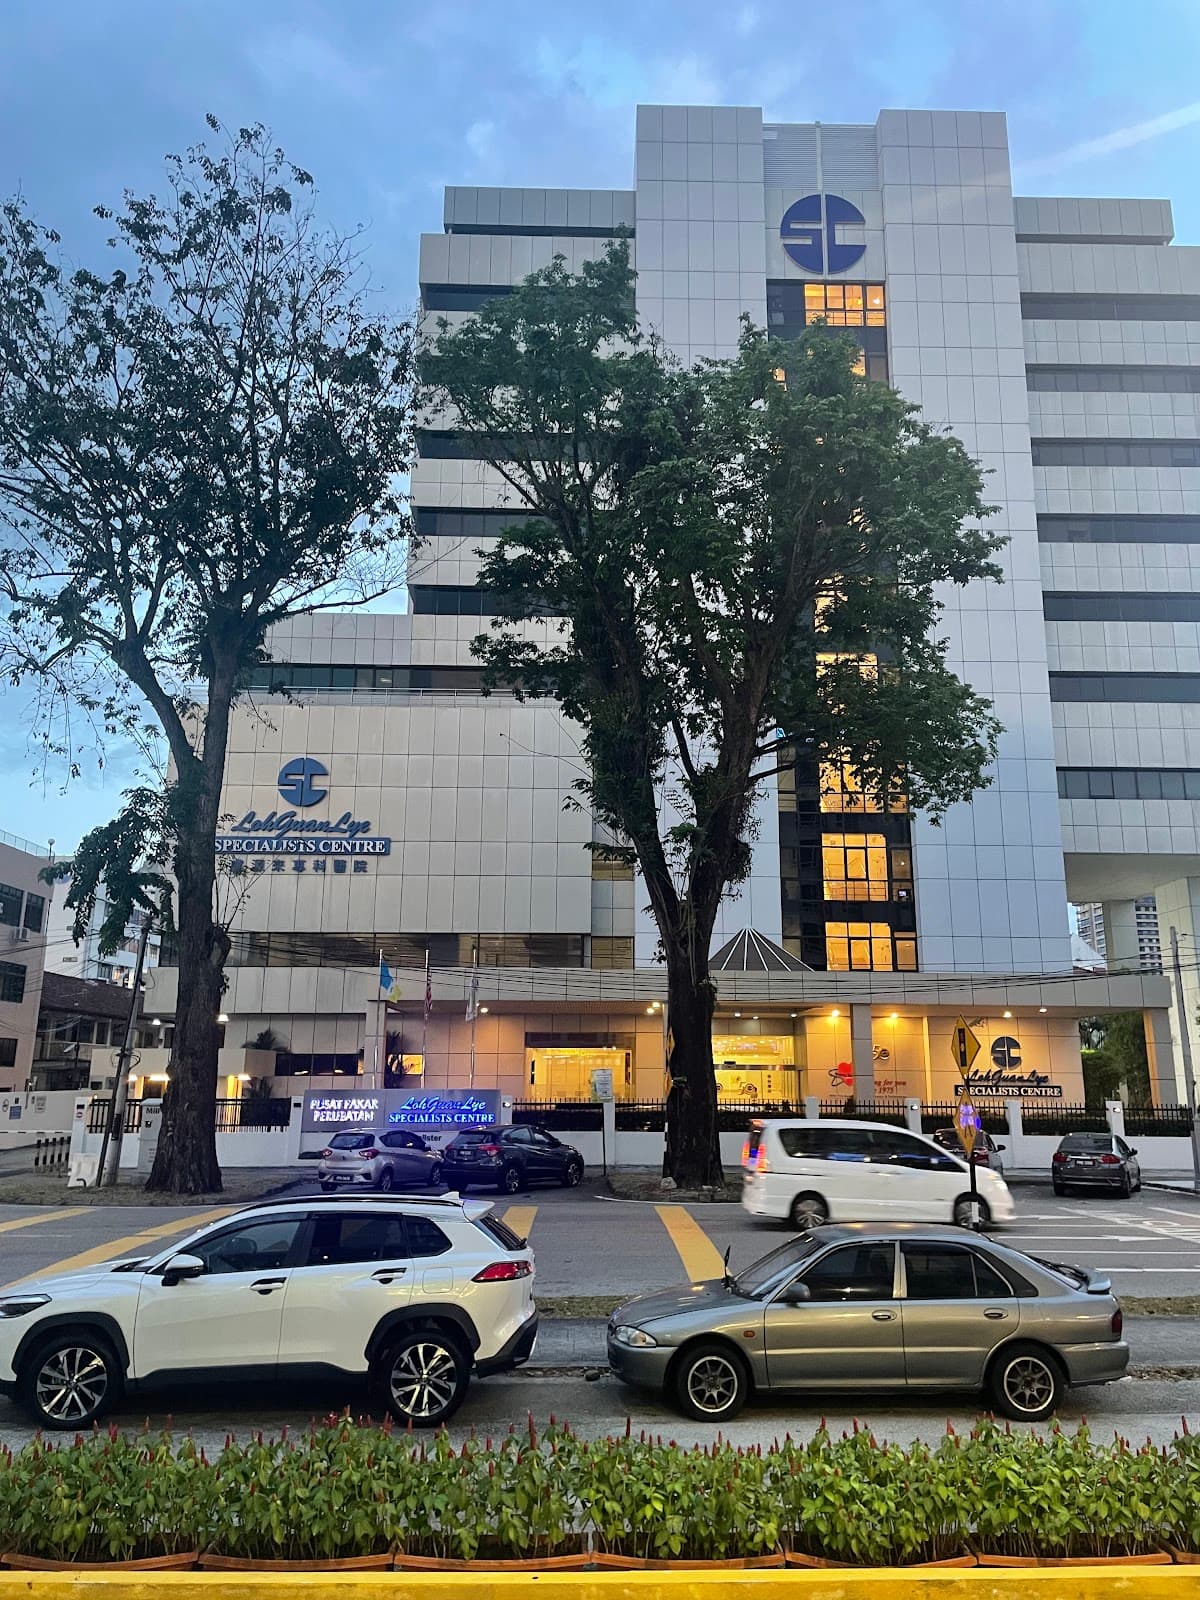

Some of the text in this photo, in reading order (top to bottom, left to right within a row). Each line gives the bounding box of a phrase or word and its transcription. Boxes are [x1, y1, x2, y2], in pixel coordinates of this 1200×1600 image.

[215, 839, 385, 853] SPECIALISTS CENTRE
[957, 1087, 1061, 1096] SECIALISTS CENTRE
[344, 1099, 379, 1110] PAKAR
[314, 1110, 375, 1122] PERUBATAN
[389, 1113, 495, 1123] SPECIALISTS CENTRE
